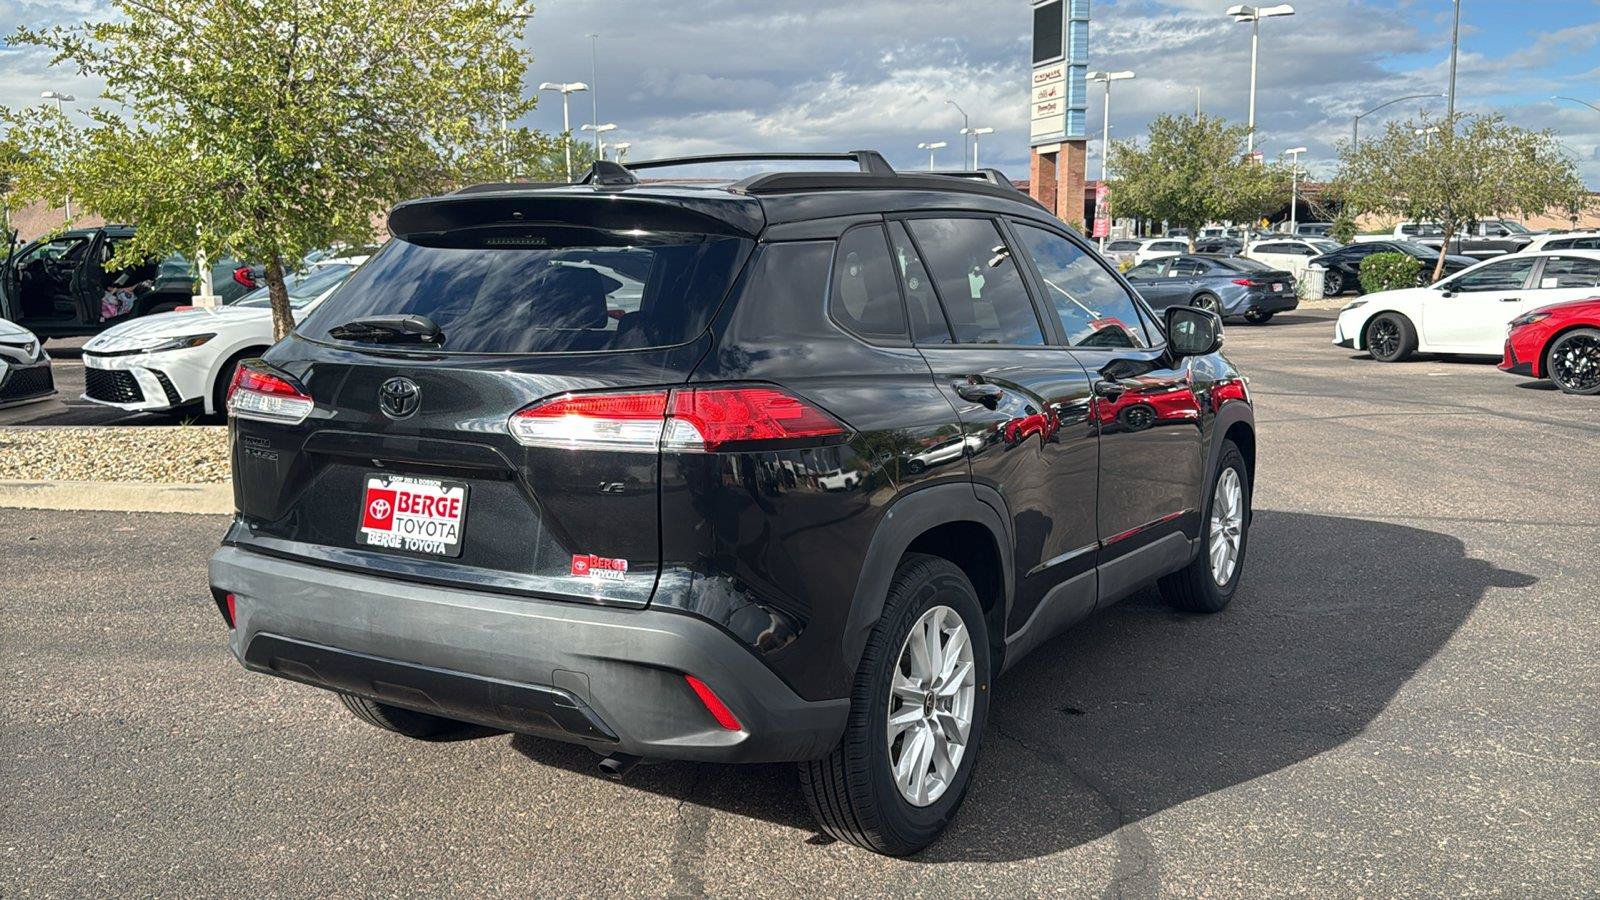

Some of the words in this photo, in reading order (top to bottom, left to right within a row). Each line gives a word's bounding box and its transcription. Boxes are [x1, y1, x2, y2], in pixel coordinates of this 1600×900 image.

[397, 491, 460, 519] BERGE
[395, 517, 457, 539] TOYOTA
[366, 532, 403, 549] BERGE
[404, 540, 446, 555] TOYOTA
[588, 567, 627, 581] TOYOTA
